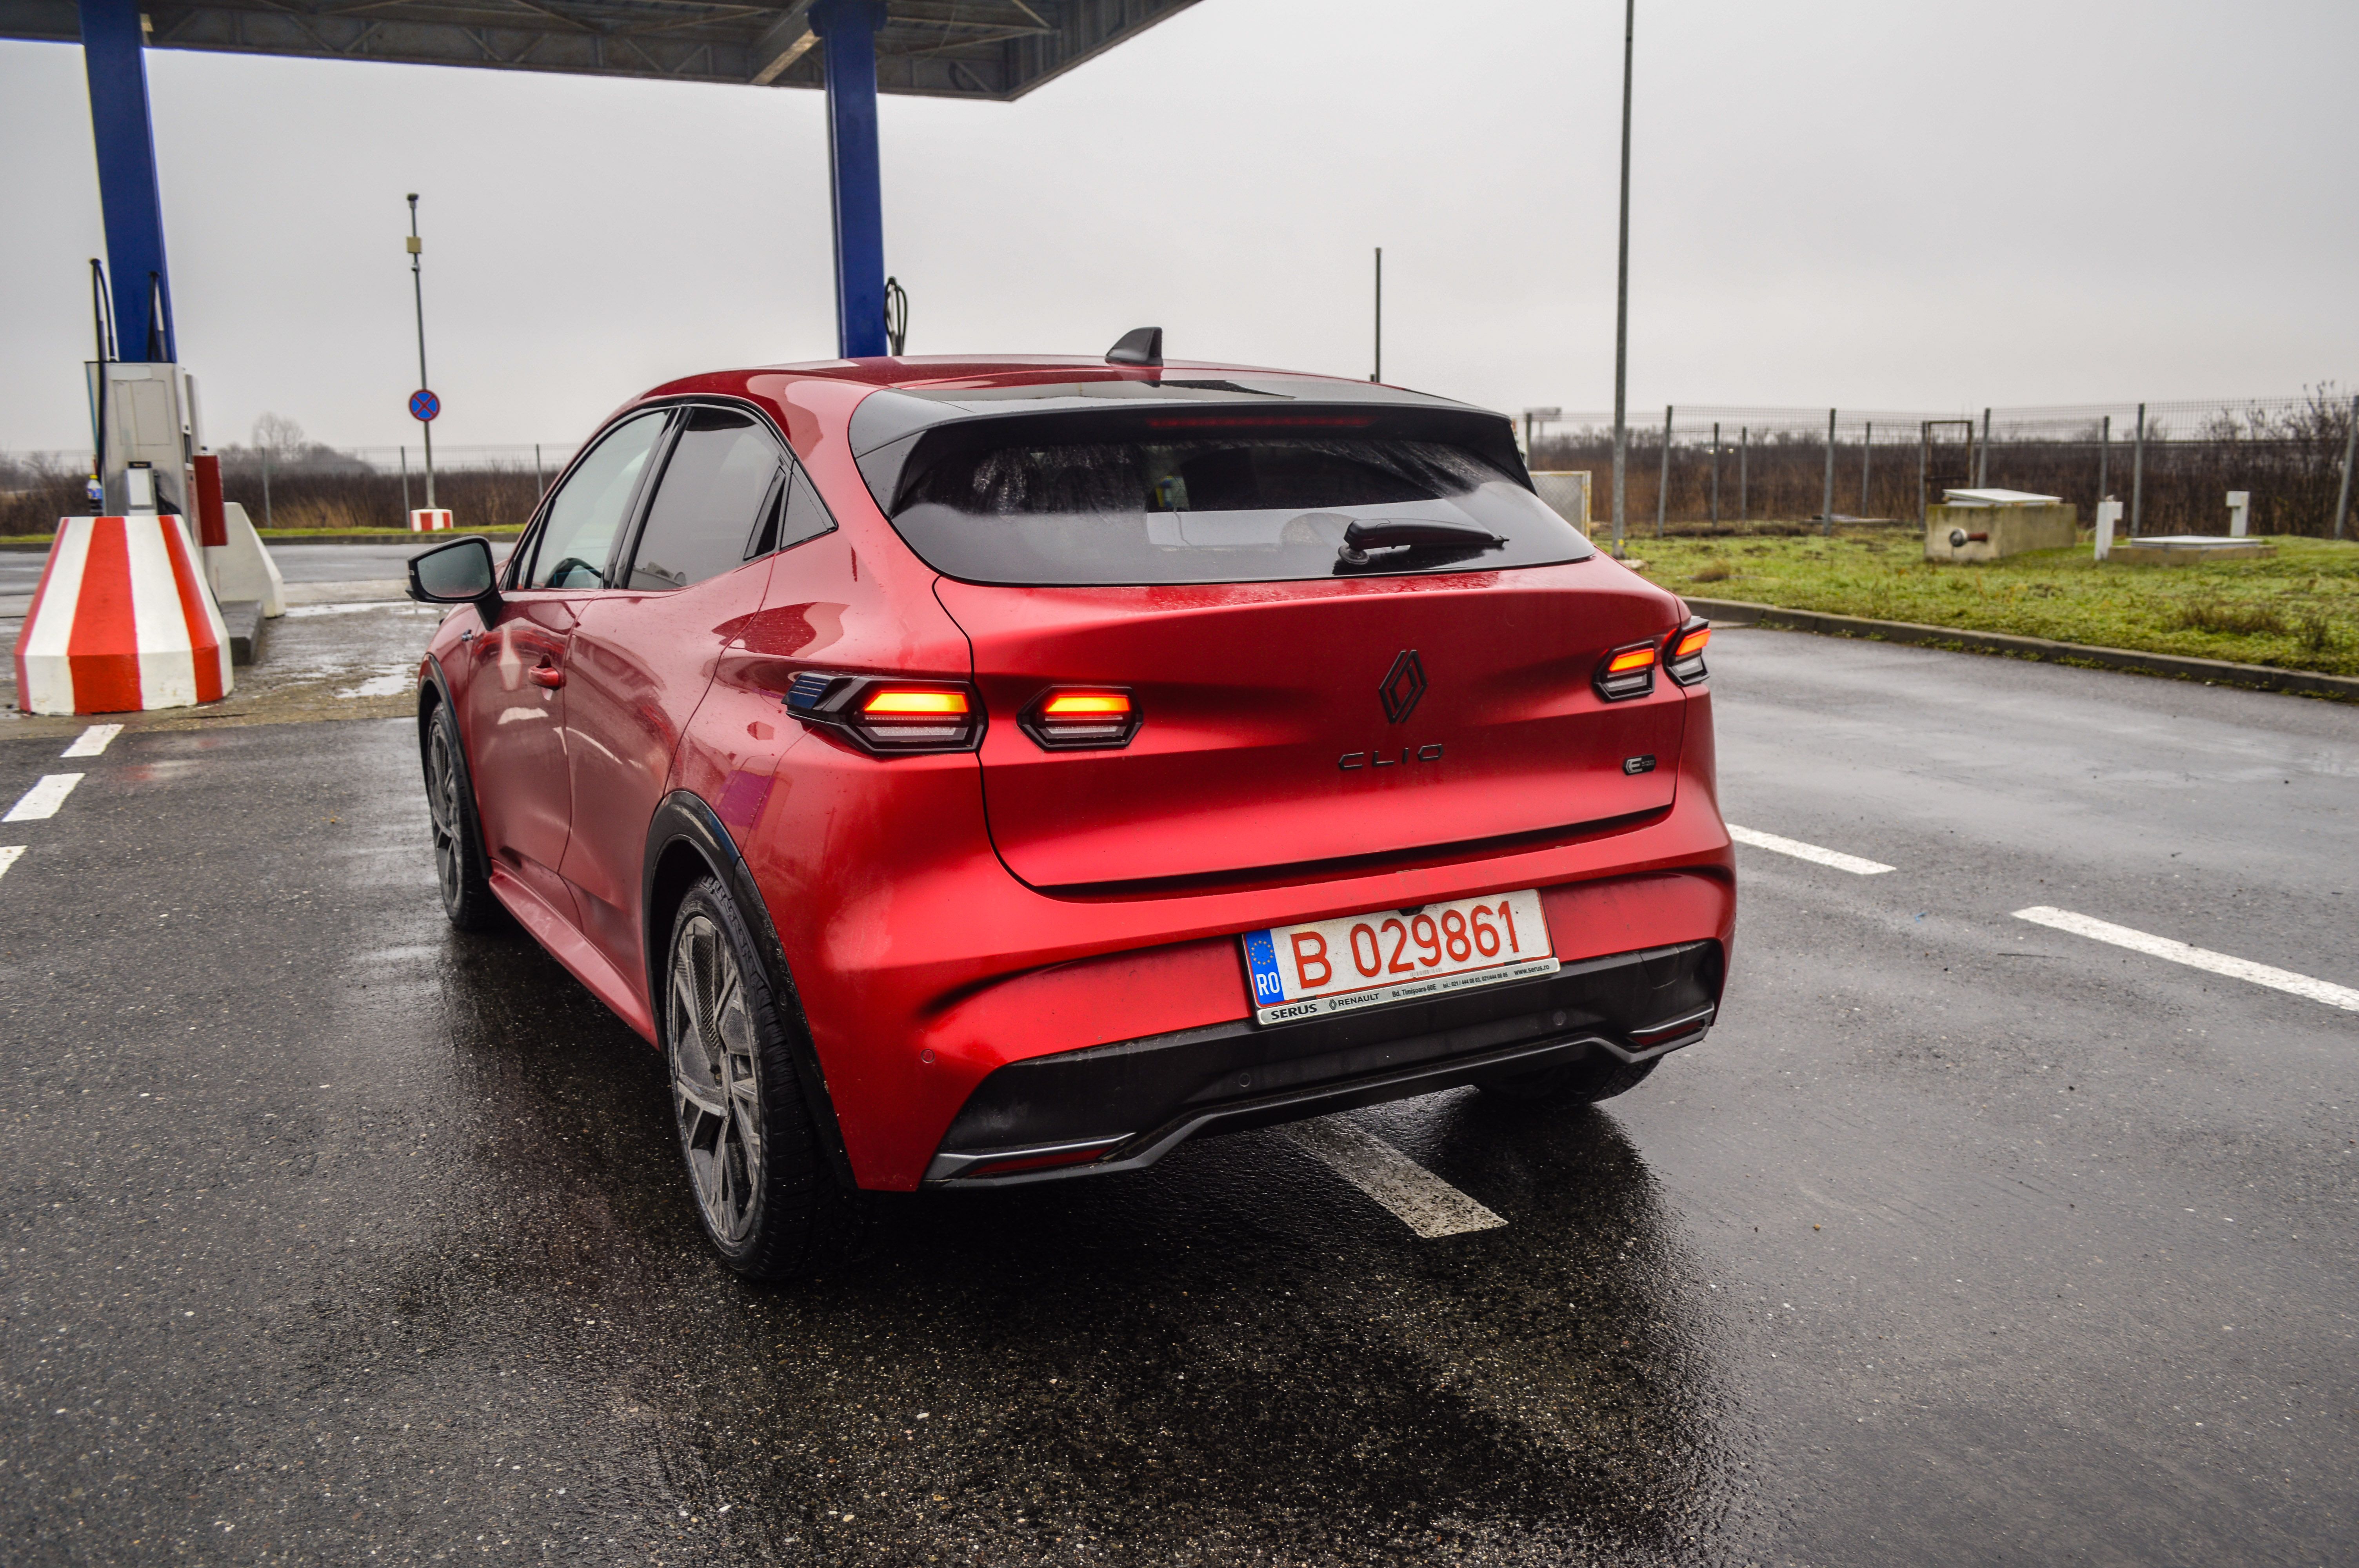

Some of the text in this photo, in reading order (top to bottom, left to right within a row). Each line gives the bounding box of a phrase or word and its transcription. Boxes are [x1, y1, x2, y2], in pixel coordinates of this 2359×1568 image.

[1338, 744, 1444, 771] CLIO
[1290, 900, 1520, 989] B 029861
[1514, 965, 1550, 975] www.serus.ro
[1256, 972, 1280, 996] RO
[1270, 993, 1379, 1020] SERUS RENAULT
